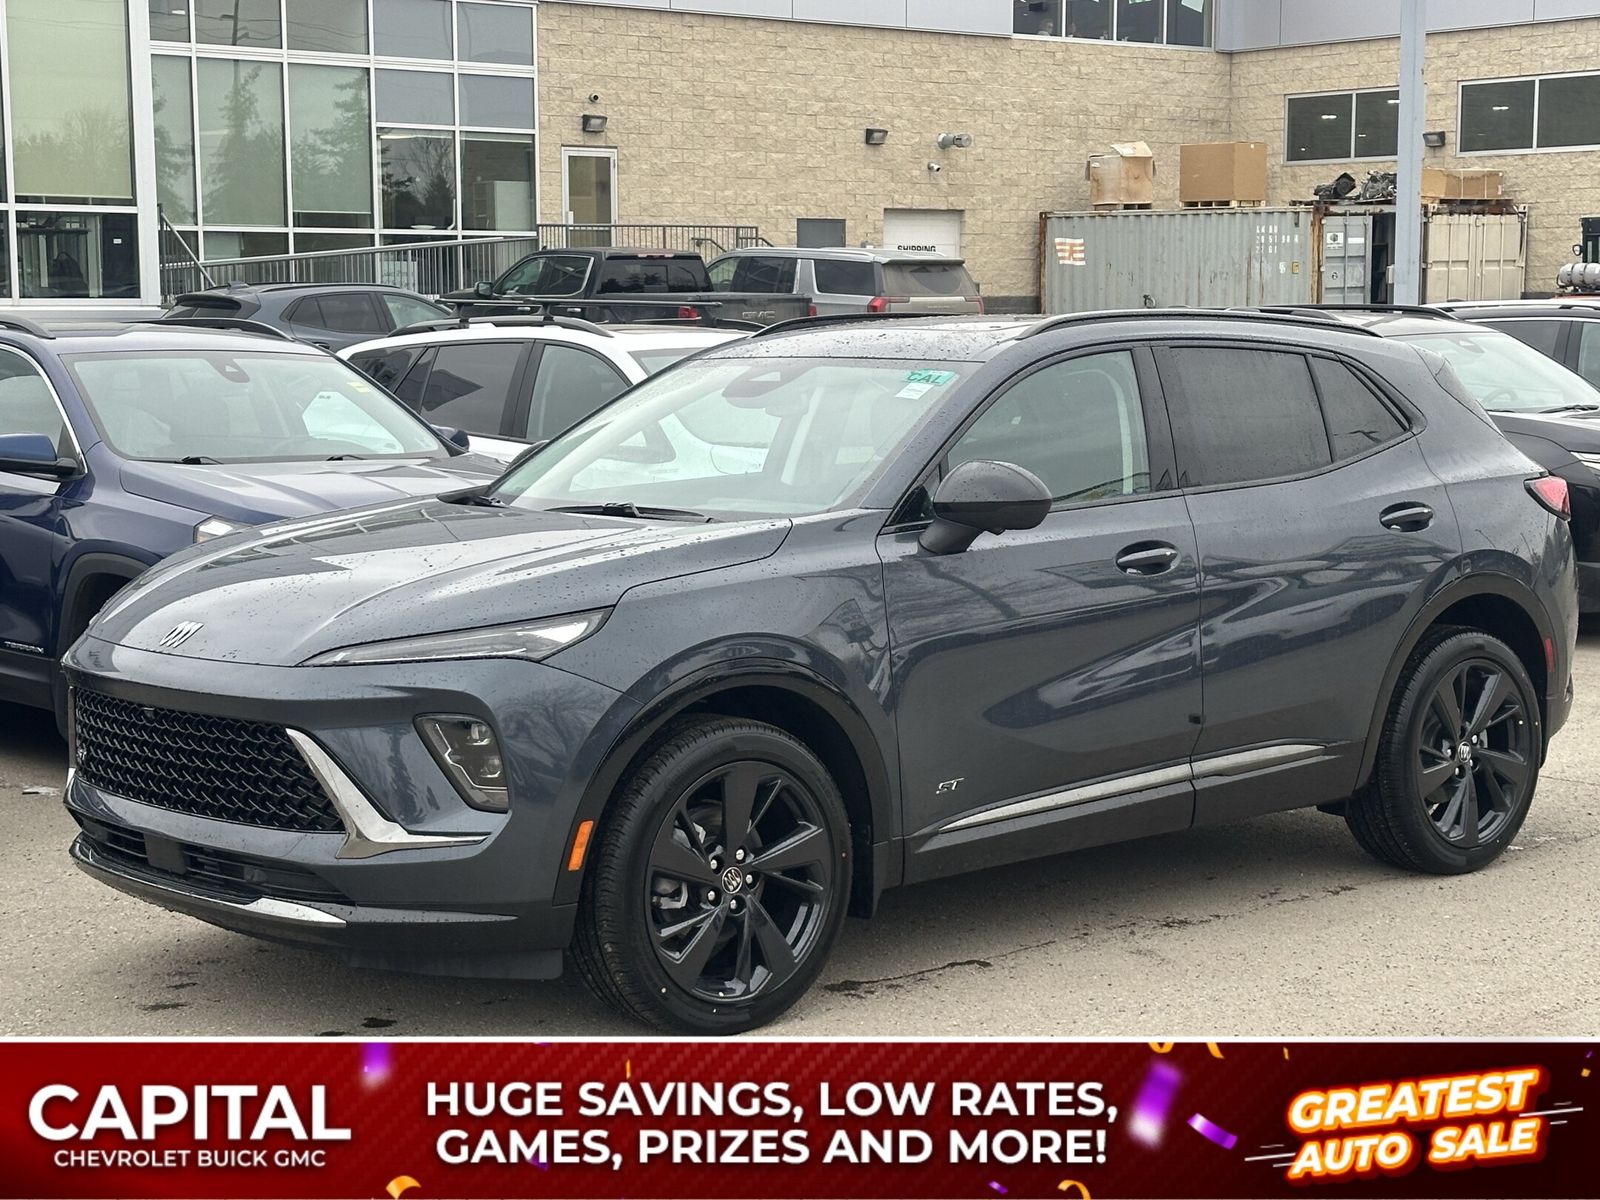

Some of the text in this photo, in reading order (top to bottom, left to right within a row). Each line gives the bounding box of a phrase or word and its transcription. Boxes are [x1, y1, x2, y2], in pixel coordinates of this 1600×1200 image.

[742, 310, 776, 320] GMC
[907, 371, 943, 384] CAL
[935, 777, 965, 795] ST
